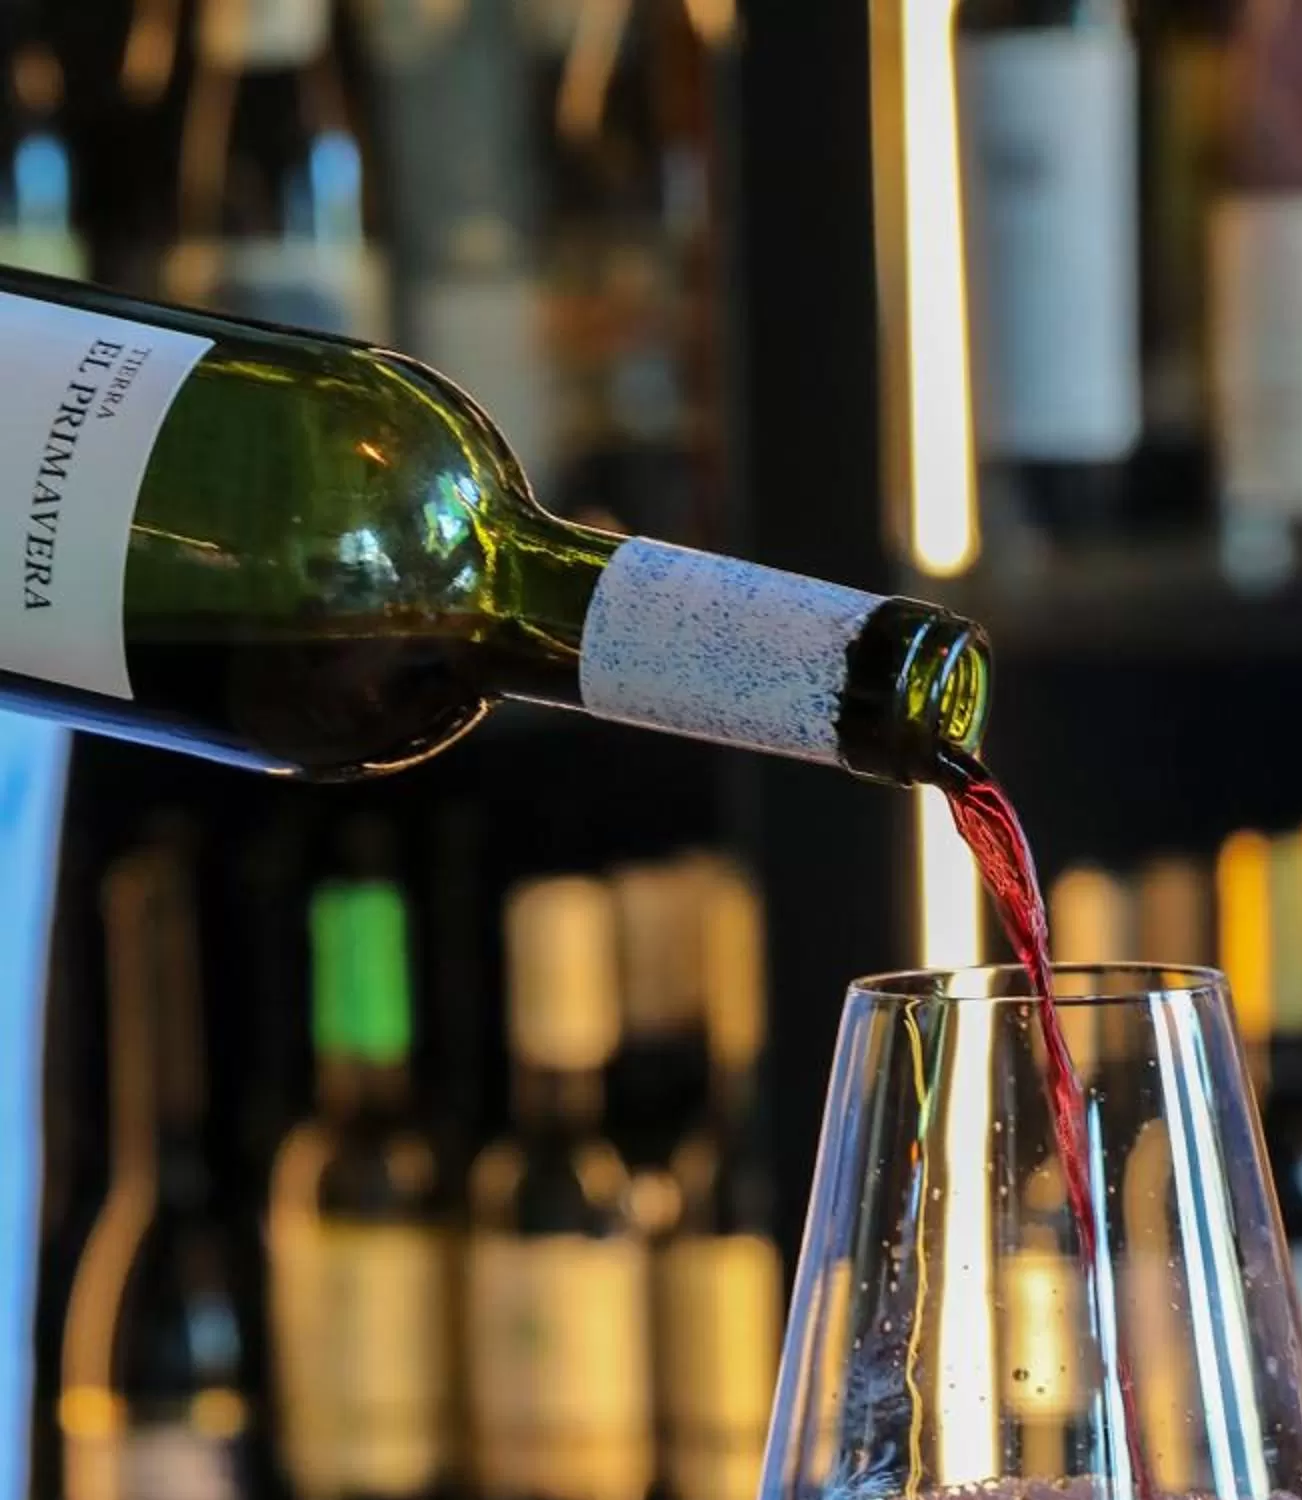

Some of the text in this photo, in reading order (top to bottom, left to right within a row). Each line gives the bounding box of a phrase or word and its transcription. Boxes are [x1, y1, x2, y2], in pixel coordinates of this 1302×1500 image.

[96, 346, 151, 420] TIERRA
[24, 337, 123, 611] EL PRIMAVERA
